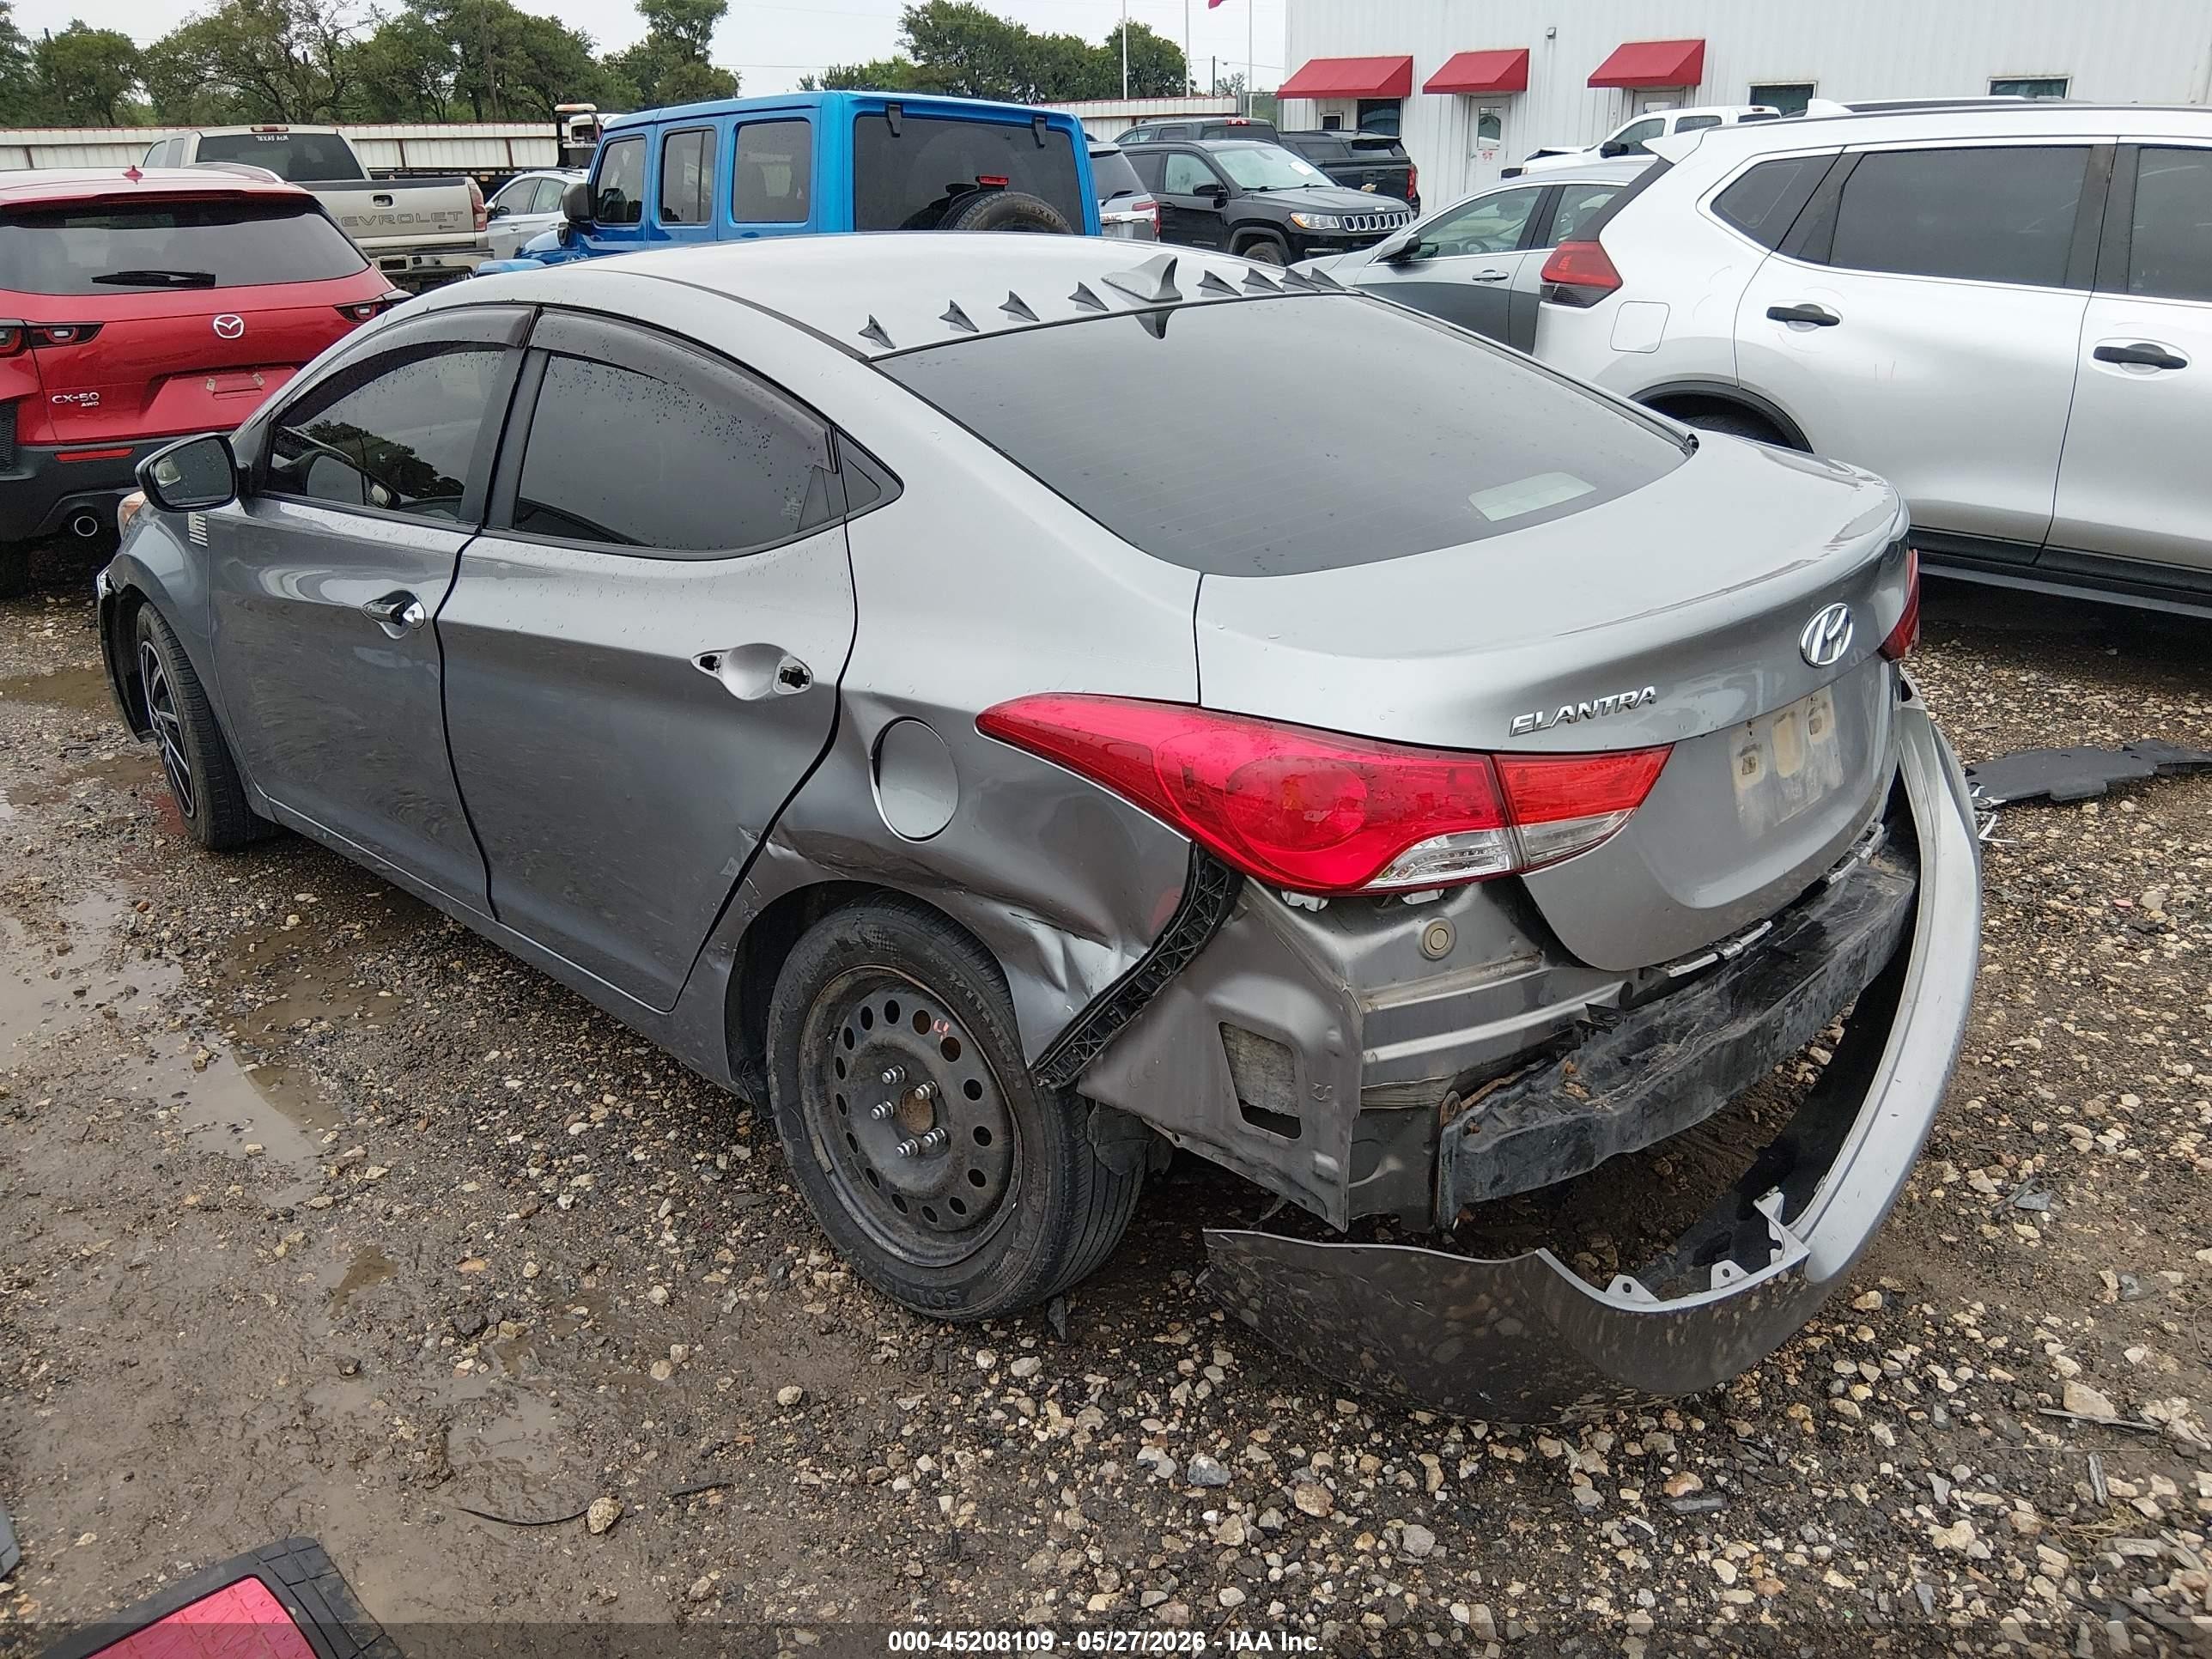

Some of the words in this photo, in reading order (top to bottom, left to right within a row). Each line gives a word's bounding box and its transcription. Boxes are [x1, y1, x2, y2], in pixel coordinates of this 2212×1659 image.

[335, 211, 464, 228] EVROLET
[52, 392, 100, 404] CX-50
[1509, 685, 1657, 738] ELANTRA
